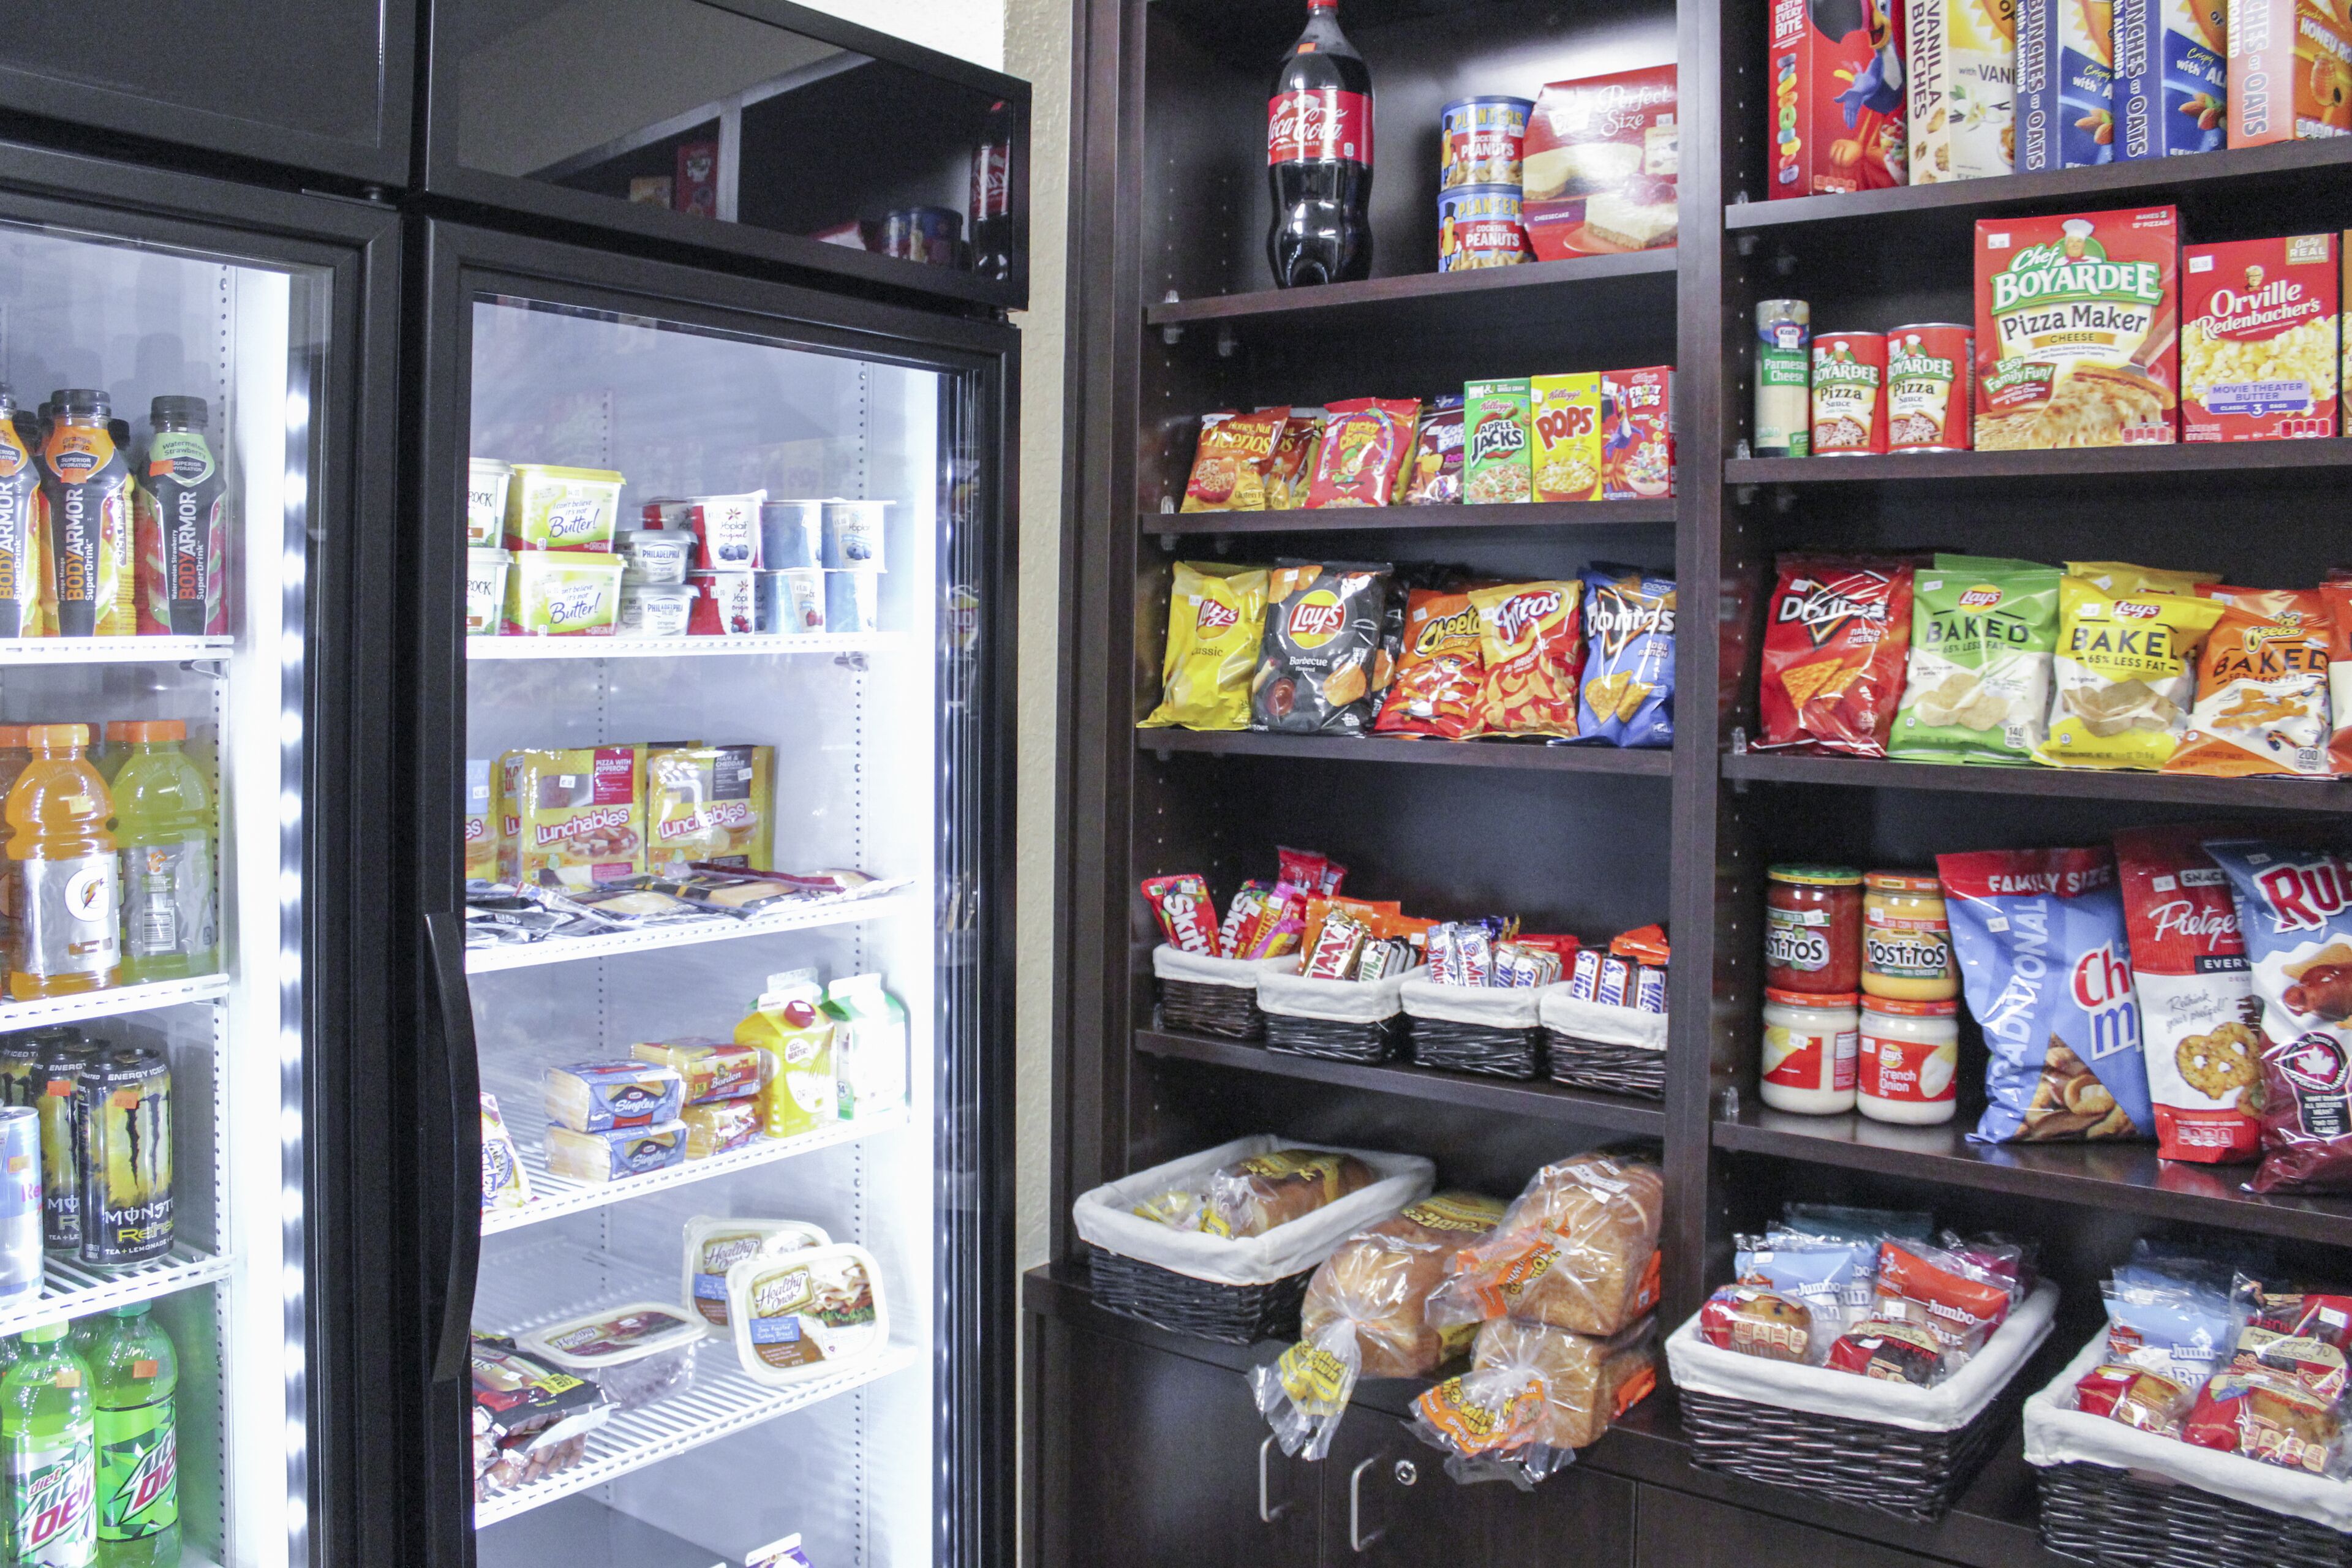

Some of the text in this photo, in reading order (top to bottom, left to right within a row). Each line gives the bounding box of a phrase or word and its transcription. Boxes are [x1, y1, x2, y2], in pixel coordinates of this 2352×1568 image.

[1776, 5, 1803, 24] EVERY
[1776, 14, 1803, 39] BITE
[2300, 17, 2338, 53] HONEY
[1927, 0, 1942, 108] VANILLA
[2114, 18, 2124, 80] ALMONDS
[1912, 5, 1928, 120] BUNCHES
[1959, 67, 1977, 75] with
[2017, 34, 2026, 94] ALMONDS
[2176, 59, 2201, 77] with
[2073, 77, 2097, 92] with
[1597, 84, 1672, 111] Perfect
[2242, 73, 2268, 138] OATS
[1600, 110, 1645, 137] Size
[2127, 96, 2148, 157] OATS
[1461, 143, 1515, 157] PEANUTS
[2026, 110, 2046, 170] OATS
[1534, 212, 1569, 221] CHEESECAKE
[1466, 233, 1520, 247] PEANUTS
[2011, 245, 2060, 273] Chef
[2290, 247, 2326, 257] REAL
[1994, 263, 2160, 309] BOYARDEE
[2211, 280, 2302, 318] Orville
[2002, 305, 2147, 341] Pizza Maker
[2196, 297, 2321, 341] Redenbacher's
[2050, 333, 2095, 344] CHEESE
[1997, 357, 2022, 372] Easy
[1771, 370, 1804, 383] Cheese
[1986, 366, 2053, 391] Family Fun!
[2252, 383, 2303, 391] THEATER
[1548, 389, 1581, 400] Kellogg's
[1629, 385, 1662, 398] FROOT
[1820, 386, 1863, 402] Pizza
[1893, 382, 1936, 397] Pizza
[2236, 393, 2279, 401] BUTTER
[1480, 400, 1514, 412] Kellogg's
[1631, 396, 1660, 409] LOOPS
[2253, 404, 2263, 415] 3
[1228, 421, 1272, 434] Honey Nut
[1480, 421, 1512, 433] APPLE
[1535, 407, 1595, 450] POPS
[1200, 426, 1272, 454] Cheerios
[1340, 433, 1378, 451] Charms
[1471, 430, 1523, 464] JACKS
[549, 508, 600, 538] Butter!
[721, 521, 748, 532] Yoplait
[0, 483, 14, 600] BODYARMOR
[66, 488, 83, 601] BODYARMOR
[178, 491, 197, 601] BODYARMOR
[643, 550, 679, 559] PHILADELPHIA
[550, 593, 601, 624] Butter!
[1960, 591, 1999, 606] Lay's
[1197, 600, 1239, 628] Lay's
[1291, 604, 1344, 635] Lay's
[1493, 592, 1562, 646] Fritos
[1587, 609, 1676, 638] Doritos
[1926, 616, 2029, 643] BAKED
[2245, 627, 2303, 653] Cheetos
[1943, 644, 1959, 654] 65%
[1962, 641, 1980, 650] LESS
[2071, 627, 2179, 660] BAKE
[1289, 657, 1328, 666] Barbecue
[2088, 655, 2166, 671] 65% LESS FAT
[2213, 649, 2328, 678] BAKED
[2008, 727, 2024, 736] 140
[2299, 749, 2318, 760] 200
[537, 809, 629, 845] Lunchables
[1988, 865, 2111, 893] FAMILY SIZE
[1868, 940, 1948, 967] TOSTITOS
[789, 1043, 801, 1052] EGG
[108, 1070, 148, 1081] ENERGY
[710, 1071, 742, 1089] Borden
[1880, 1066, 1917, 1081] French
[1879, 1079, 1910, 1093] Onion
[614, 1098, 654, 1112] Singles
[105, 1197, 173, 1225] MONST
[129, 1240, 167, 1253] LEMONADE
[705, 1240, 758, 1268] Healthy
[755, 1272, 807, 1311] Healthy
[771, 1292, 797, 1310] Ones
[1929, 1299, 1975, 1325] Jumbo
[757, 1333, 776, 1342] Turkey
